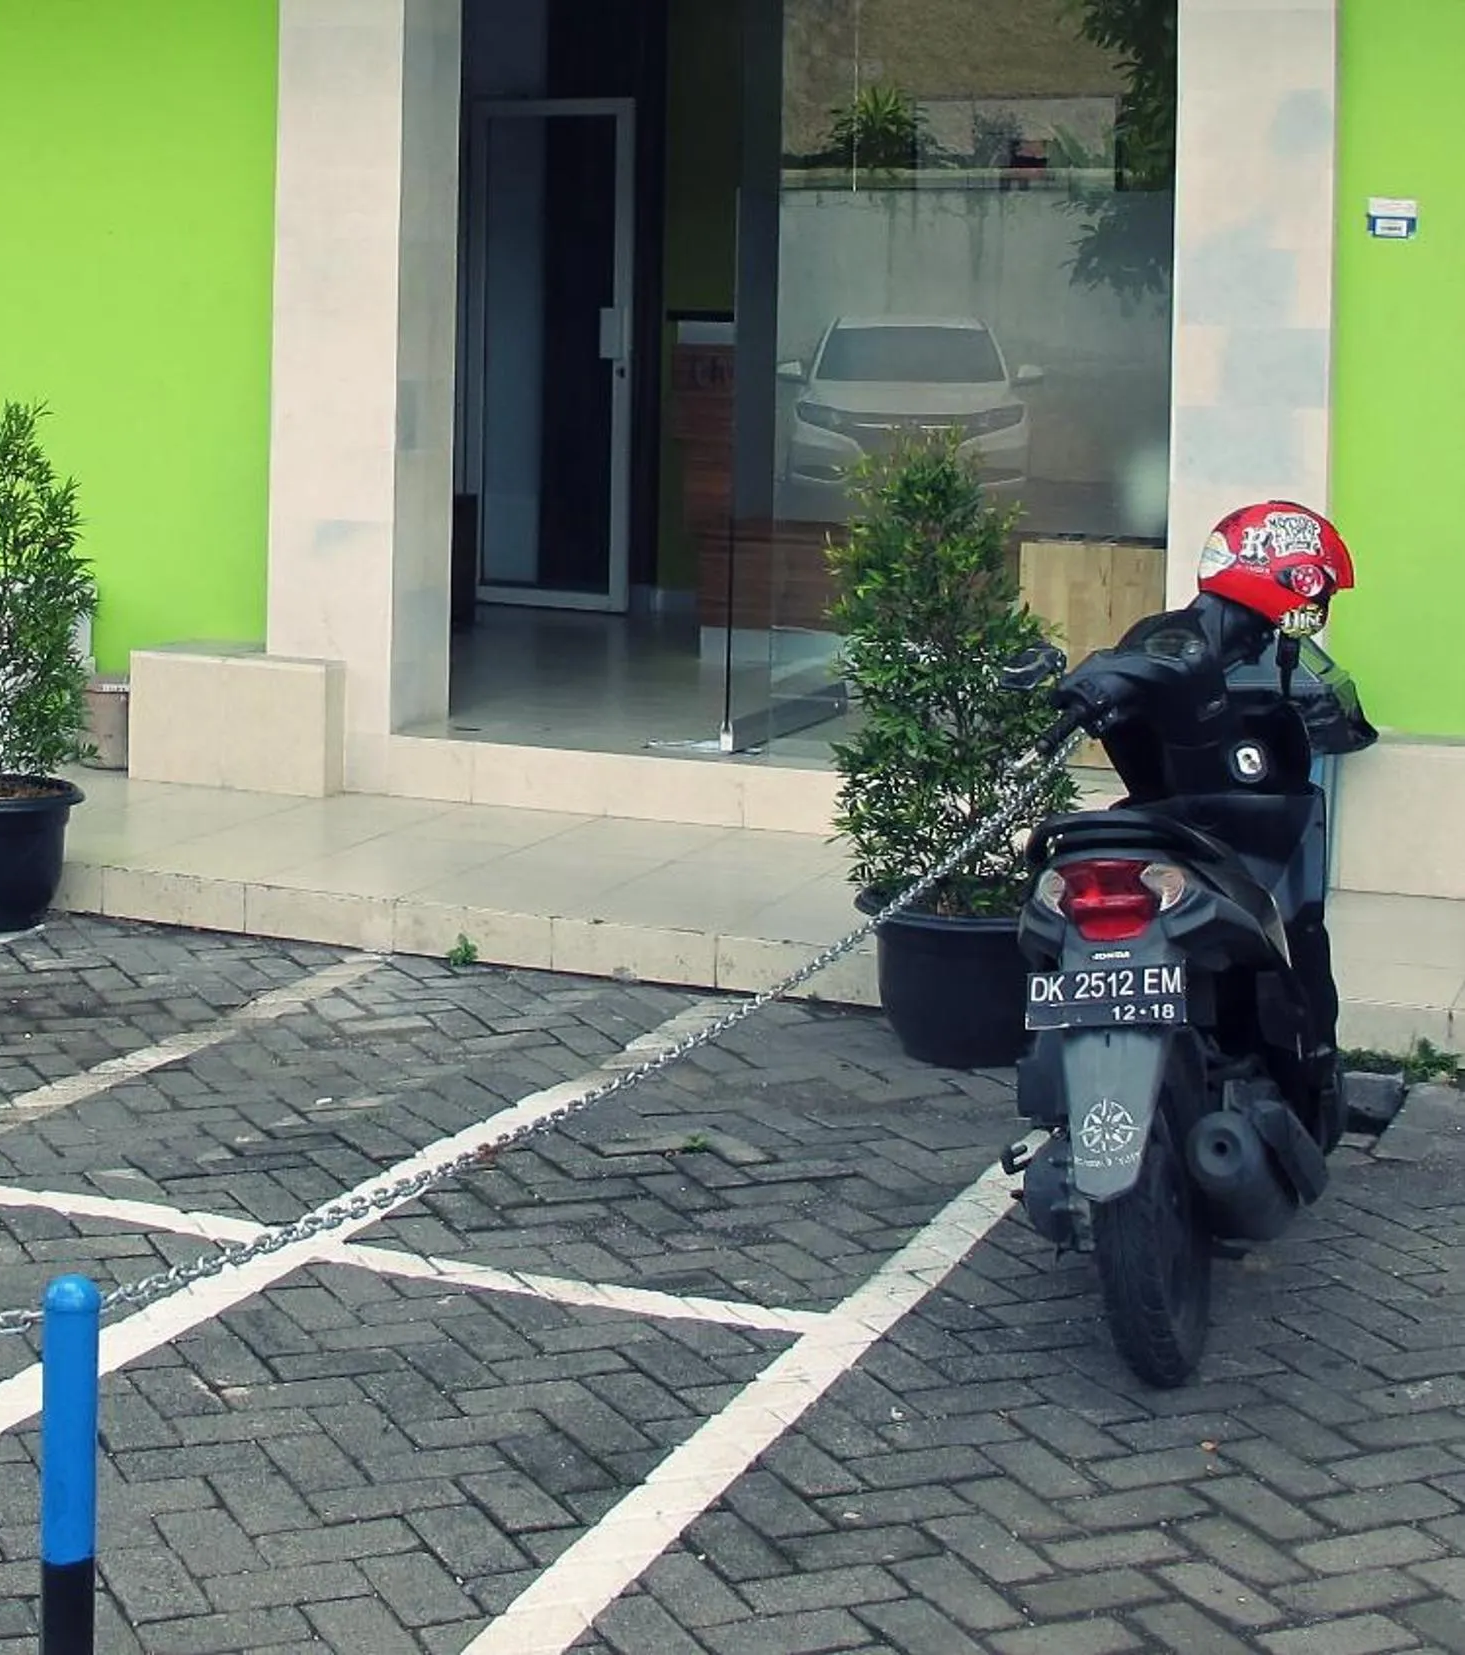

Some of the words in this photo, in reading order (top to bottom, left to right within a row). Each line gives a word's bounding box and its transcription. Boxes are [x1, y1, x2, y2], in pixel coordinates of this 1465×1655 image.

[1031, 975, 1066, 1002] DK
[1074, 969, 1134, 999] 2512
[1143, 966, 1182, 995] EM
